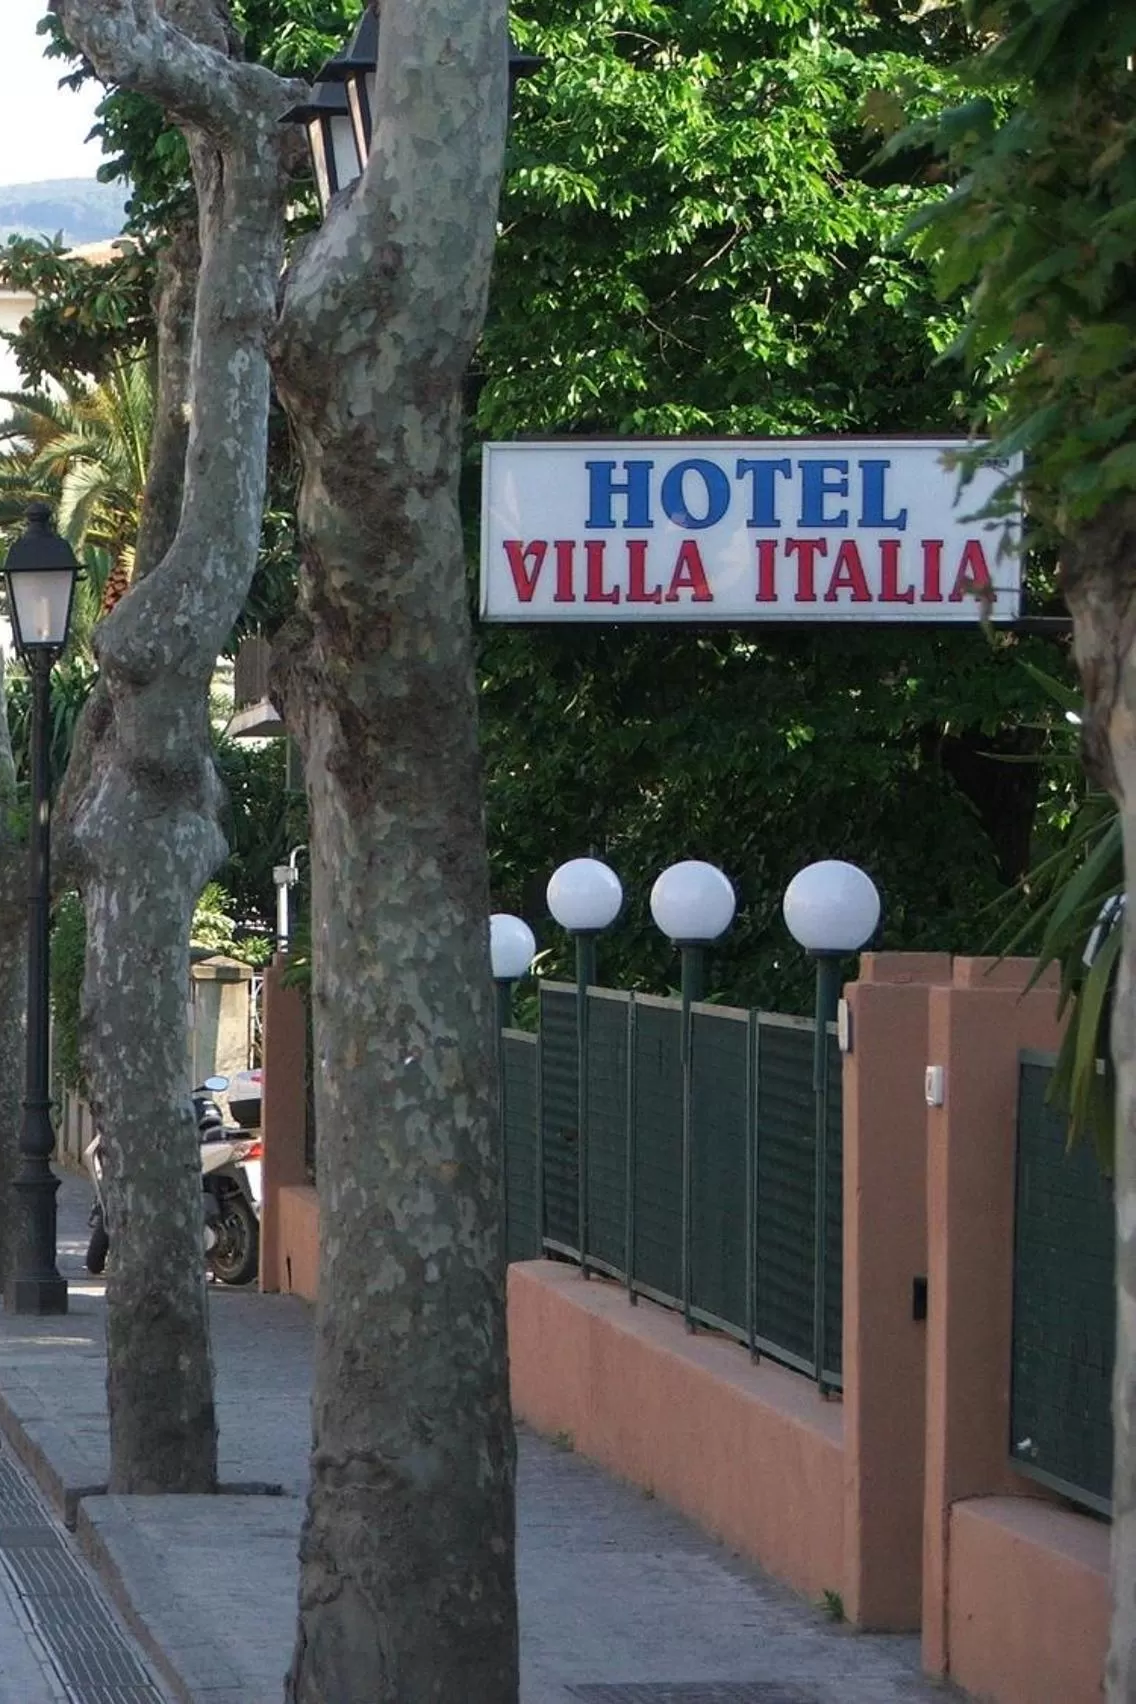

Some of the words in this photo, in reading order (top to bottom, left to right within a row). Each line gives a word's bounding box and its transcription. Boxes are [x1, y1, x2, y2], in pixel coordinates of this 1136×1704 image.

[584, 458, 908, 531] HOTEL
[502, 539, 714, 604] VILLA
[755, 537, 998, 604] ITALIA
